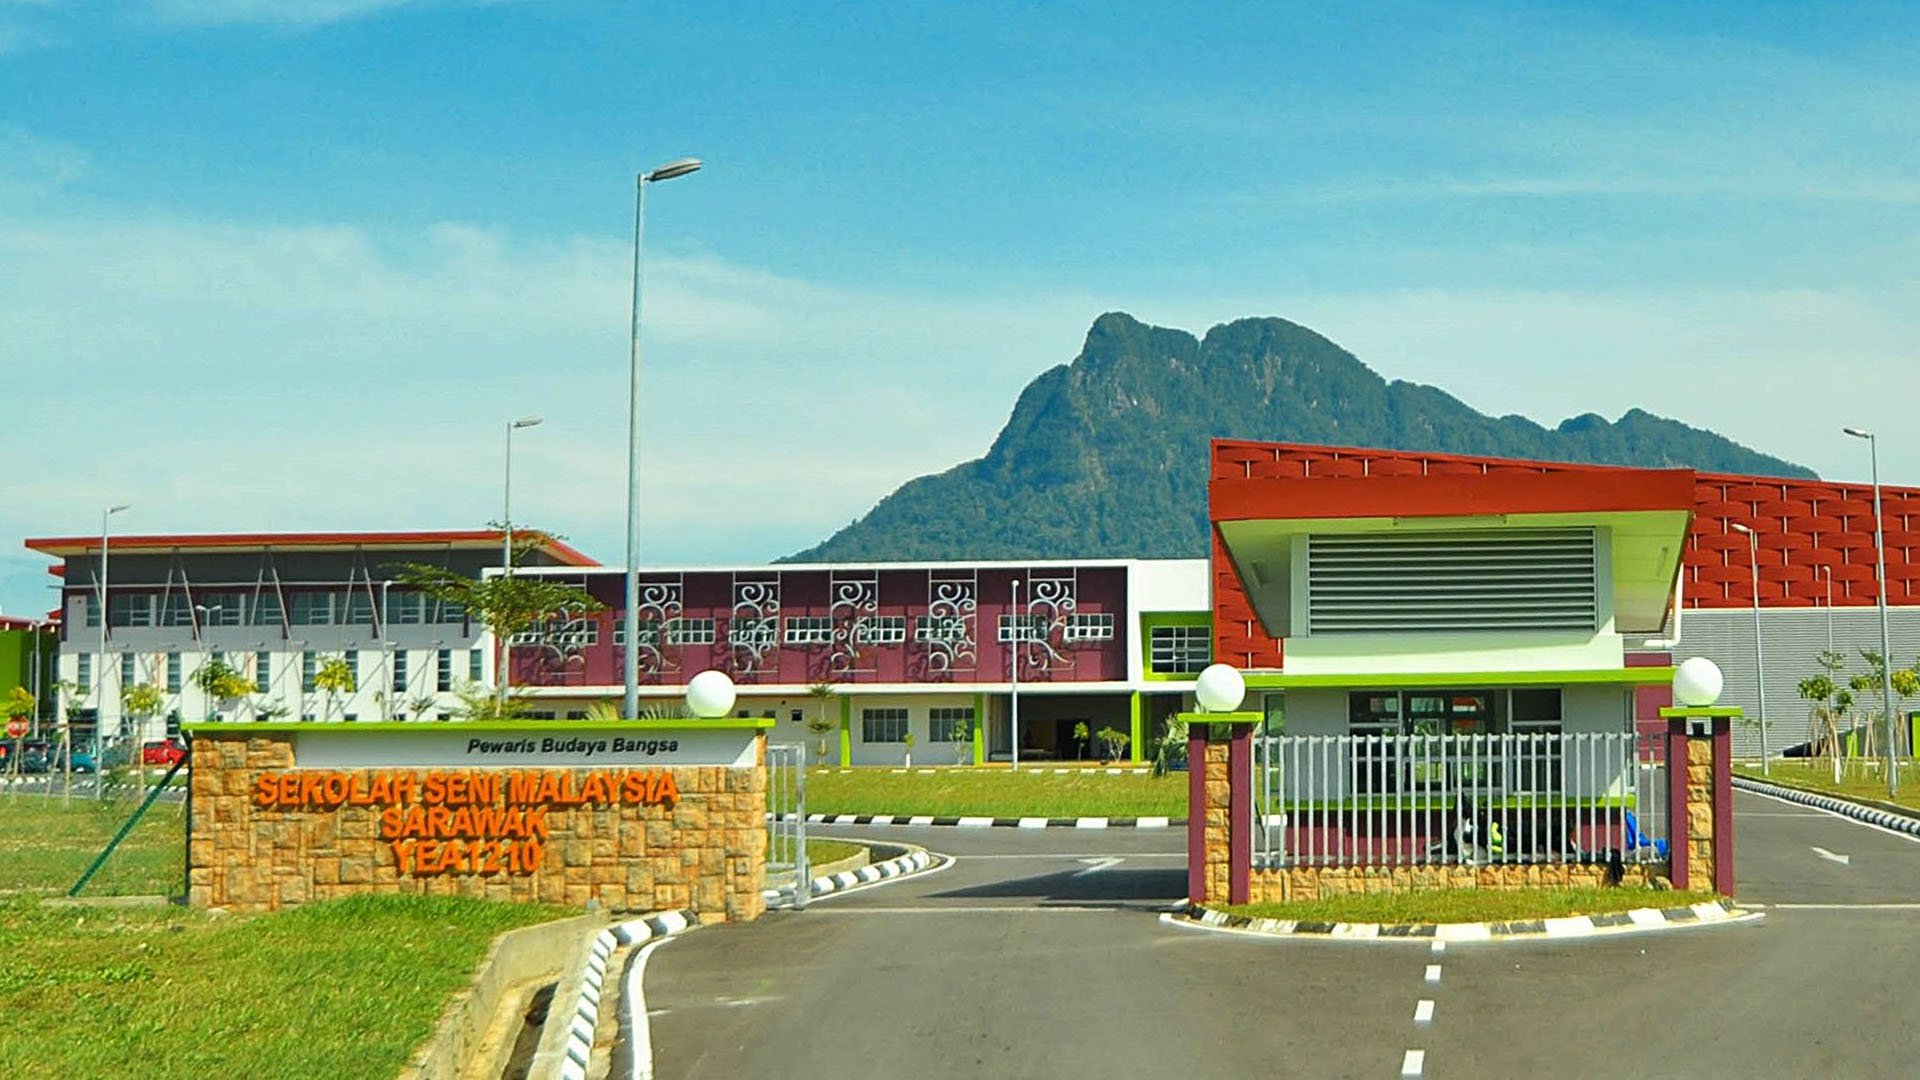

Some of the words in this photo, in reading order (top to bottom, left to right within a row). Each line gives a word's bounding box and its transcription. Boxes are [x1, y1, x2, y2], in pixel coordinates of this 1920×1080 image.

[467, 738, 536, 754] Pewaris
[541, 738, 606, 755] Budaya
[612, 738, 678, 755] Bangsa
[258, 772, 415, 804] SEKOLAH
[425, 772, 501, 803] SENI
[510, 771, 679, 804] MALAYSIA
[382, 806, 548, 839] SARAWAK
[393, 839, 542, 872] YEA1210
